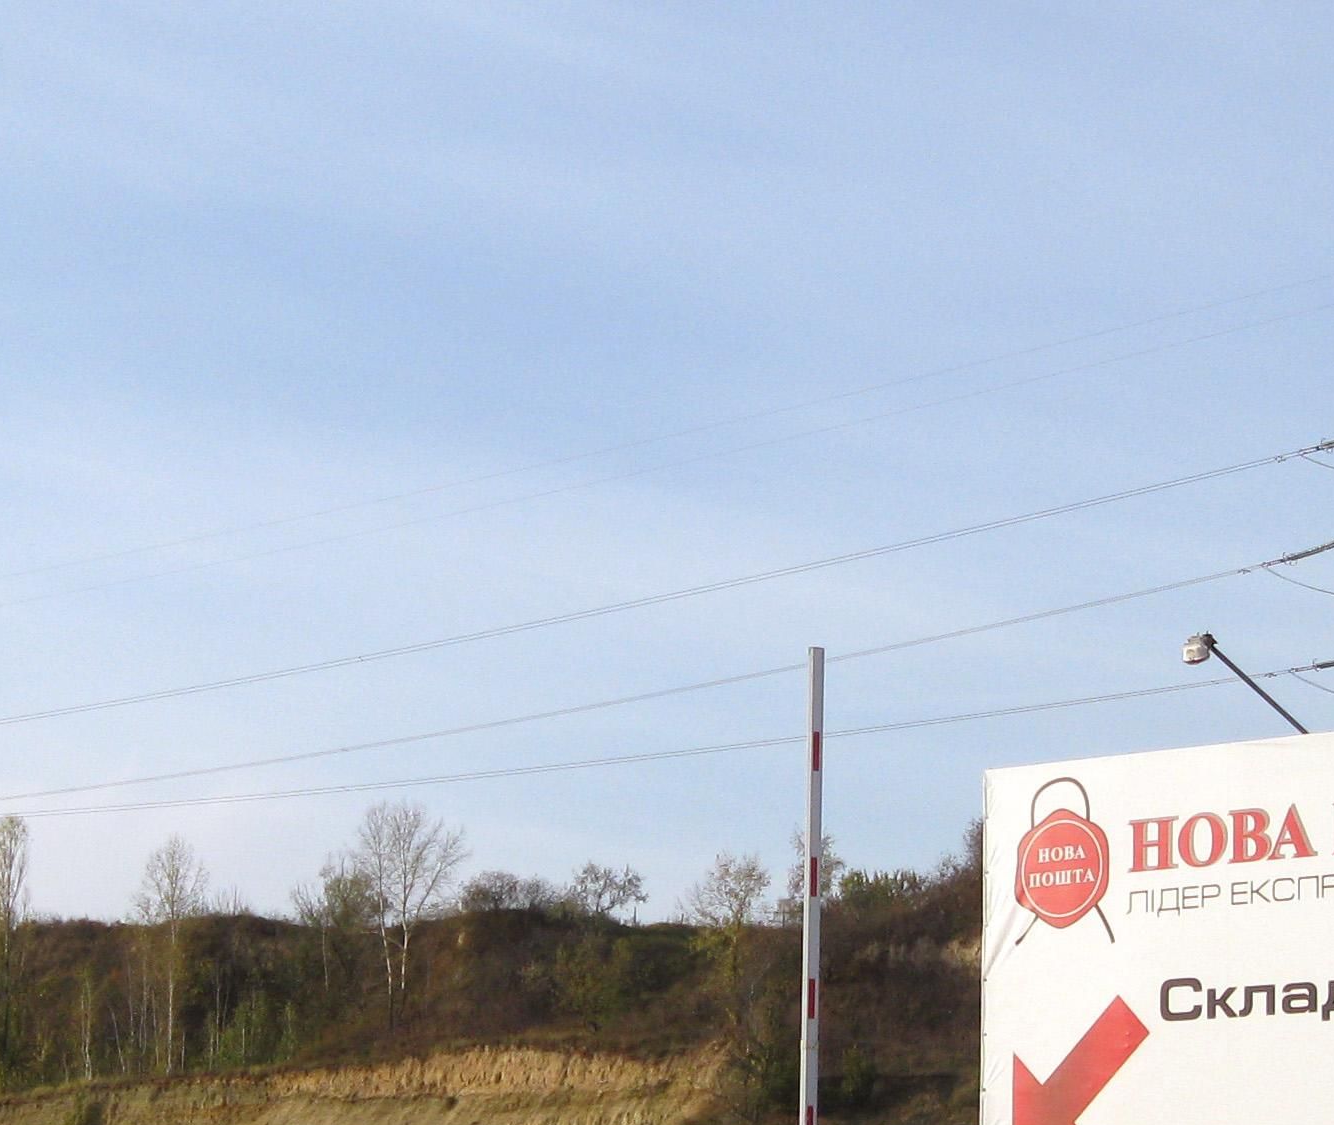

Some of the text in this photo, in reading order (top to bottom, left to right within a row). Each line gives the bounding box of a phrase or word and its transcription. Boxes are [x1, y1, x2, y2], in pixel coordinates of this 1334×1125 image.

[1127, 803, 1318, 873] НОВА
[1037, 844, 1087, 864] НОВА
[1028, 867, 1096, 889] ПОШТА
[1126, 883, 1222, 917] ЛІДЕР
